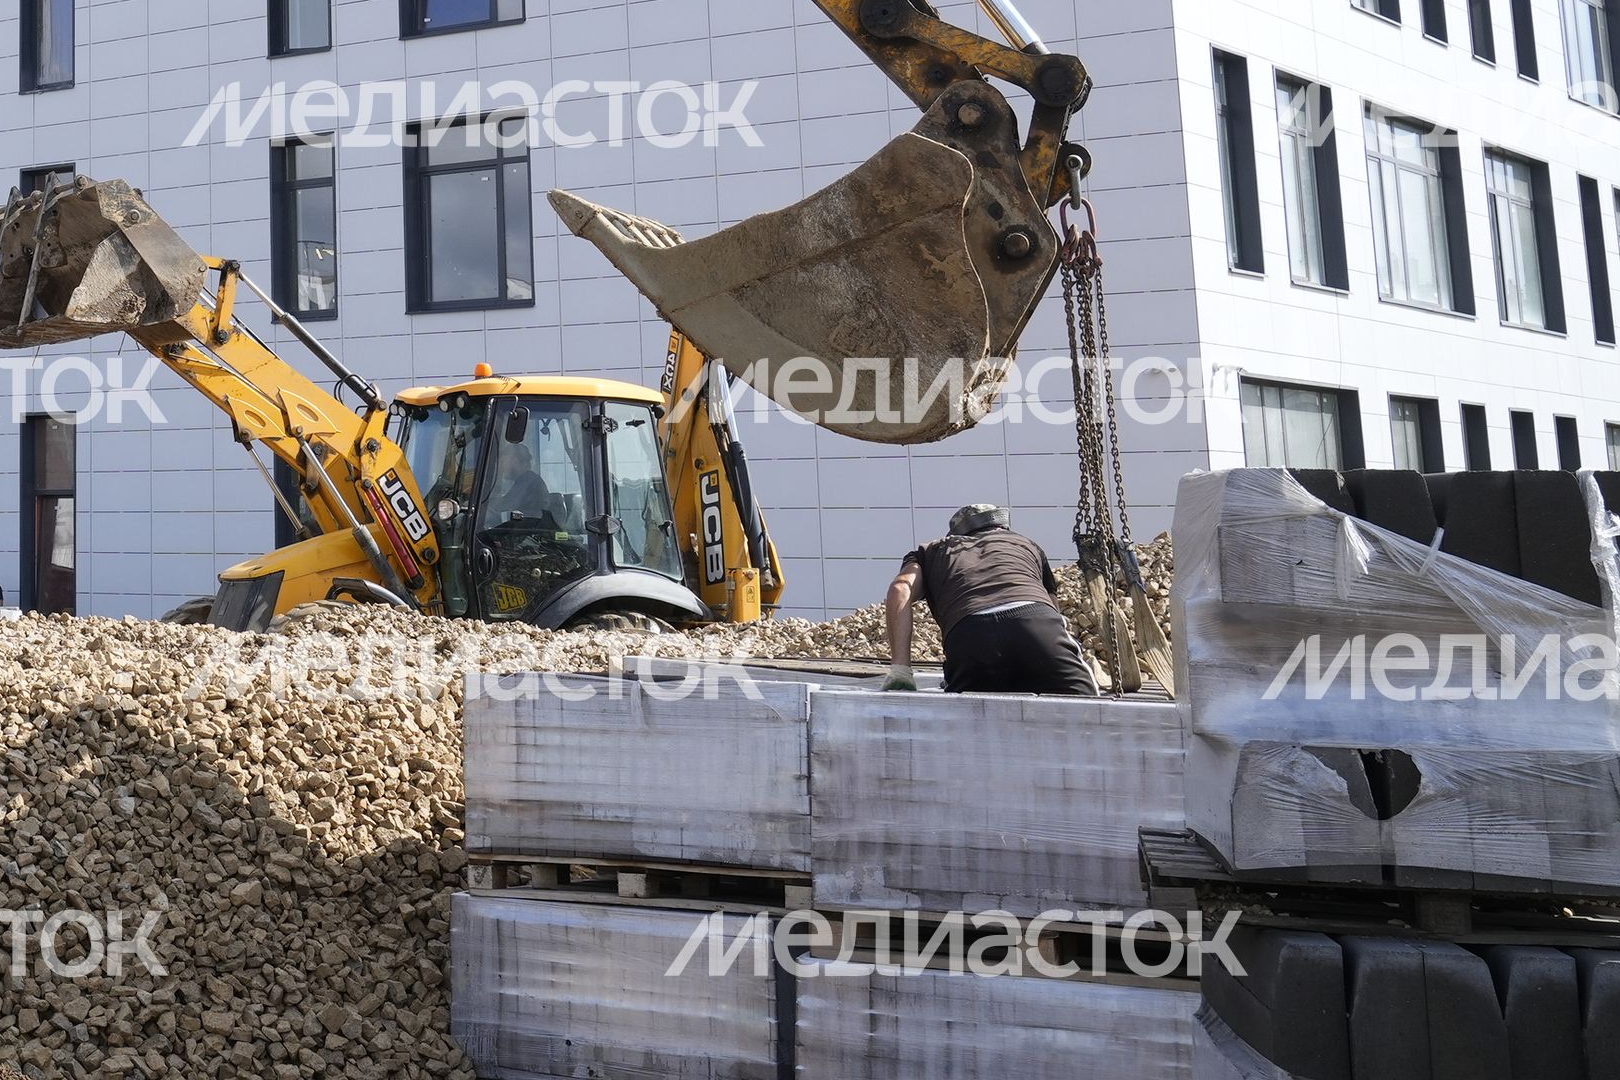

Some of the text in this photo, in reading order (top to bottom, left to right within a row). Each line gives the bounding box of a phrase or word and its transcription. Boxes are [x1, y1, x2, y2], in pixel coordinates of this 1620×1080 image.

[663, 352, 676, 389] 4CX
[379, 475, 428, 541] JCB
[701, 475, 724, 582] JCB
[494, 583, 525, 610] JCB
